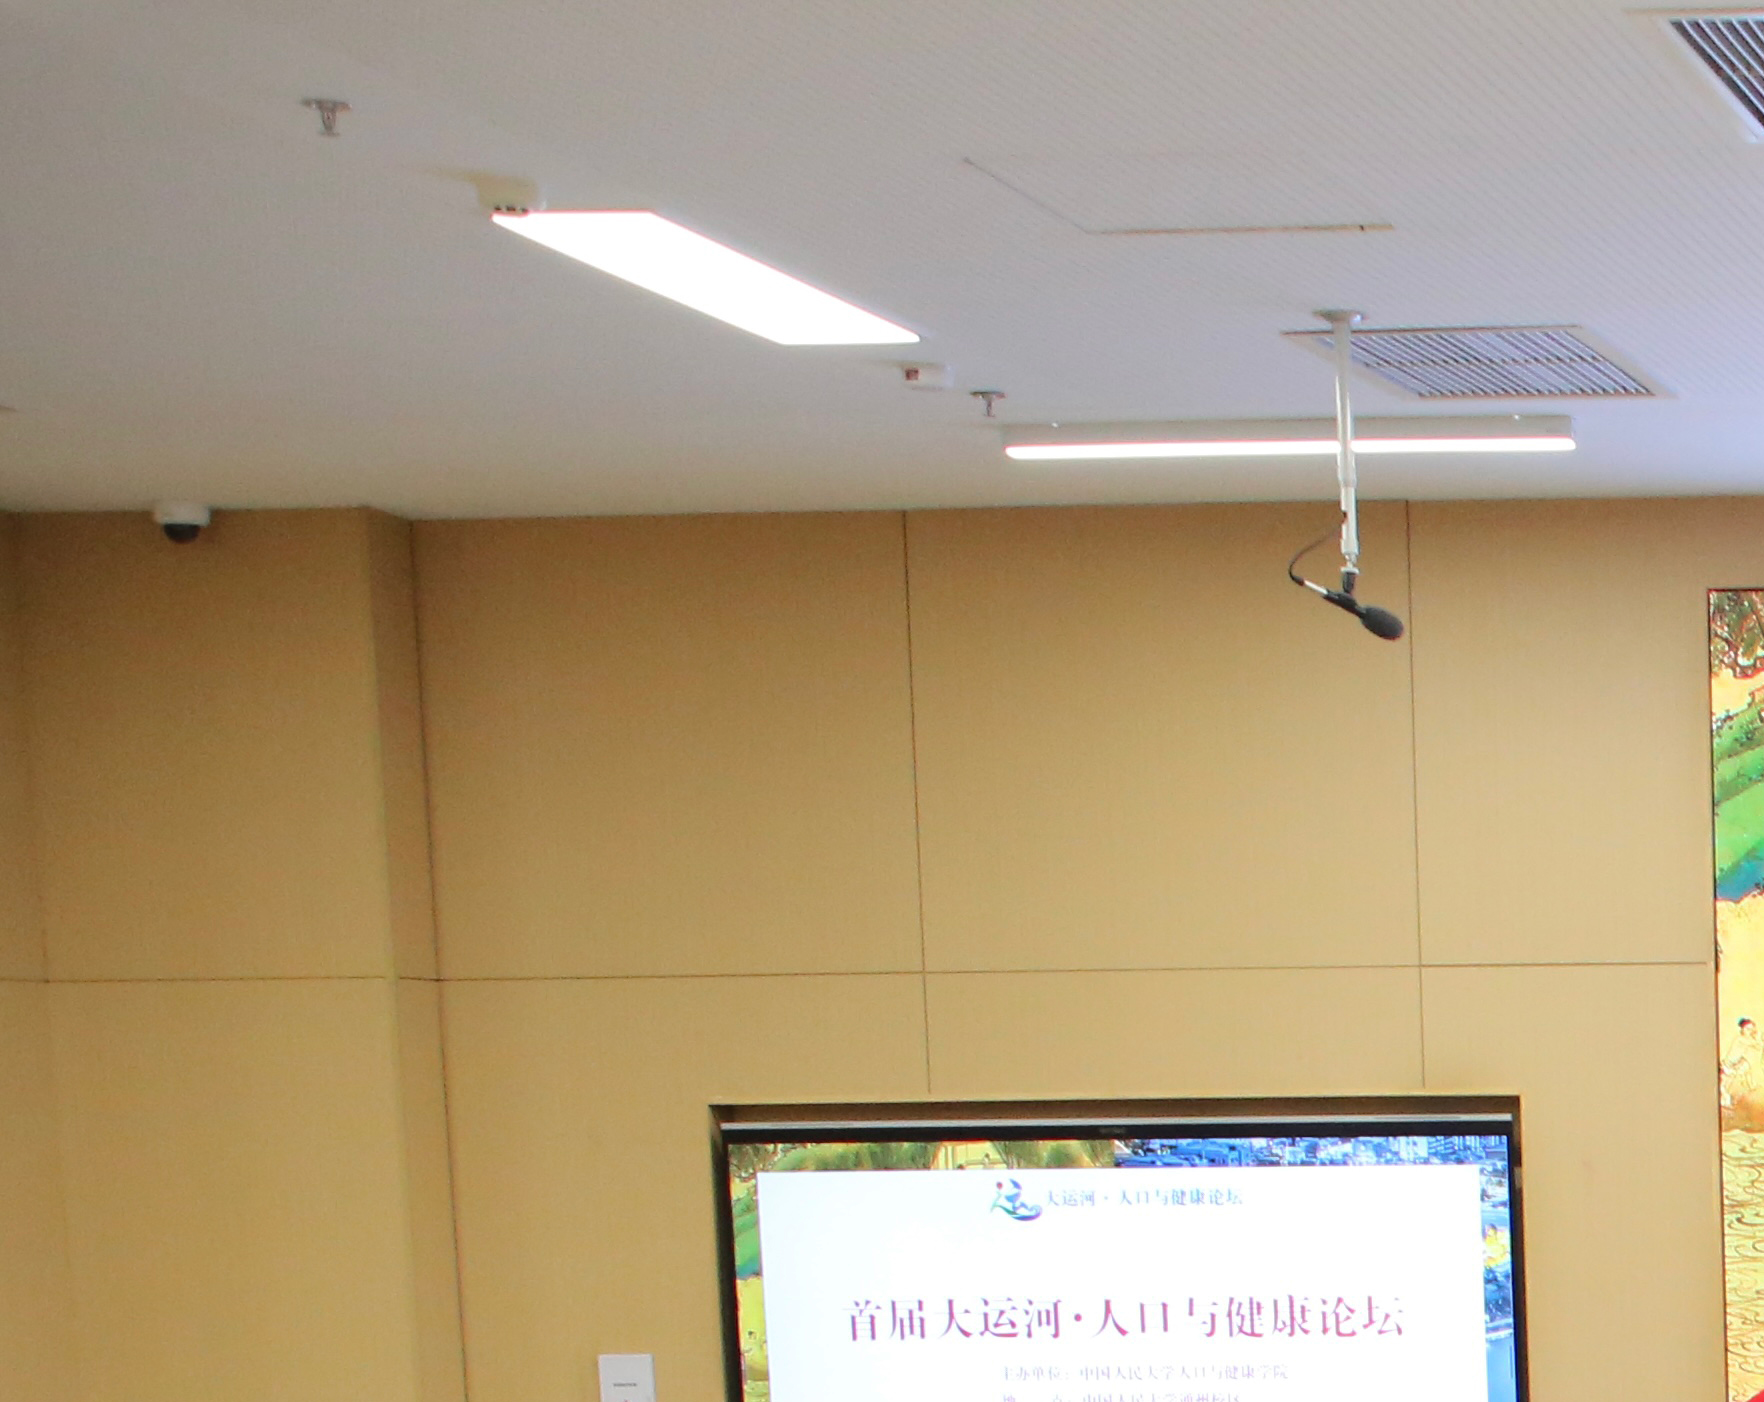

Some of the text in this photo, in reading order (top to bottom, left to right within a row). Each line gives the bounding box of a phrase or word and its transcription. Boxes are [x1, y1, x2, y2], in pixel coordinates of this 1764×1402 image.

[842, 1294, 1406, 1343] 首届大运河·人口与健康论坛
